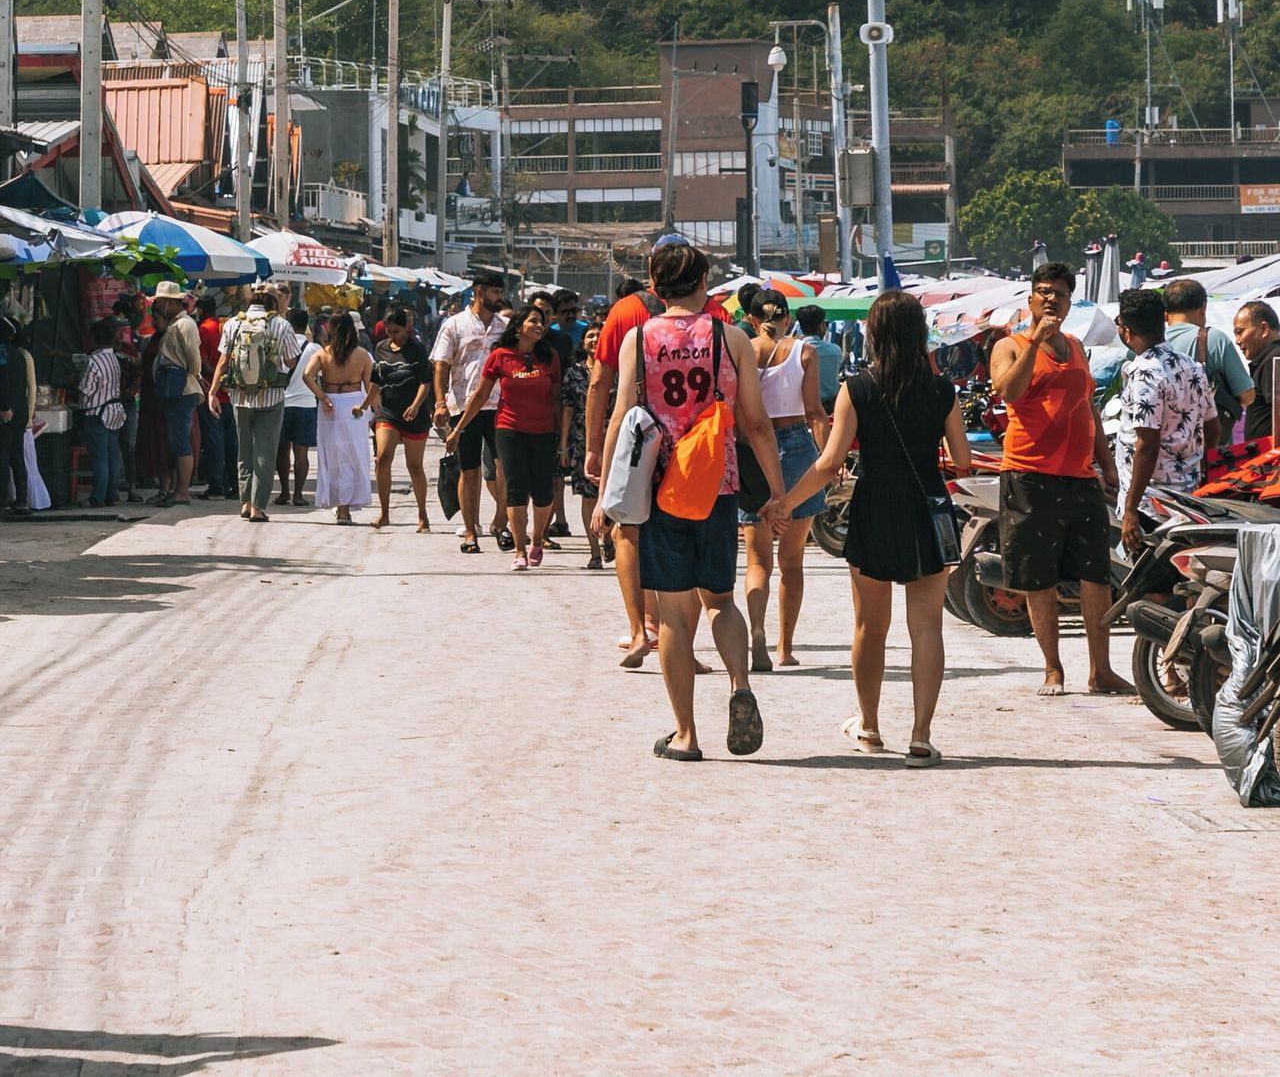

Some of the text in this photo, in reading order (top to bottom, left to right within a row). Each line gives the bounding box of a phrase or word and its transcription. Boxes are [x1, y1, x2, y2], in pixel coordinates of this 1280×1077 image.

[1247, 188, 1265, 196] FOR
[300, 248, 331, 259] STEL
[300, 257, 342, 269] ARTO
[657, 344, 710, 362] Anson
[662, 366, 711, 407] 89
